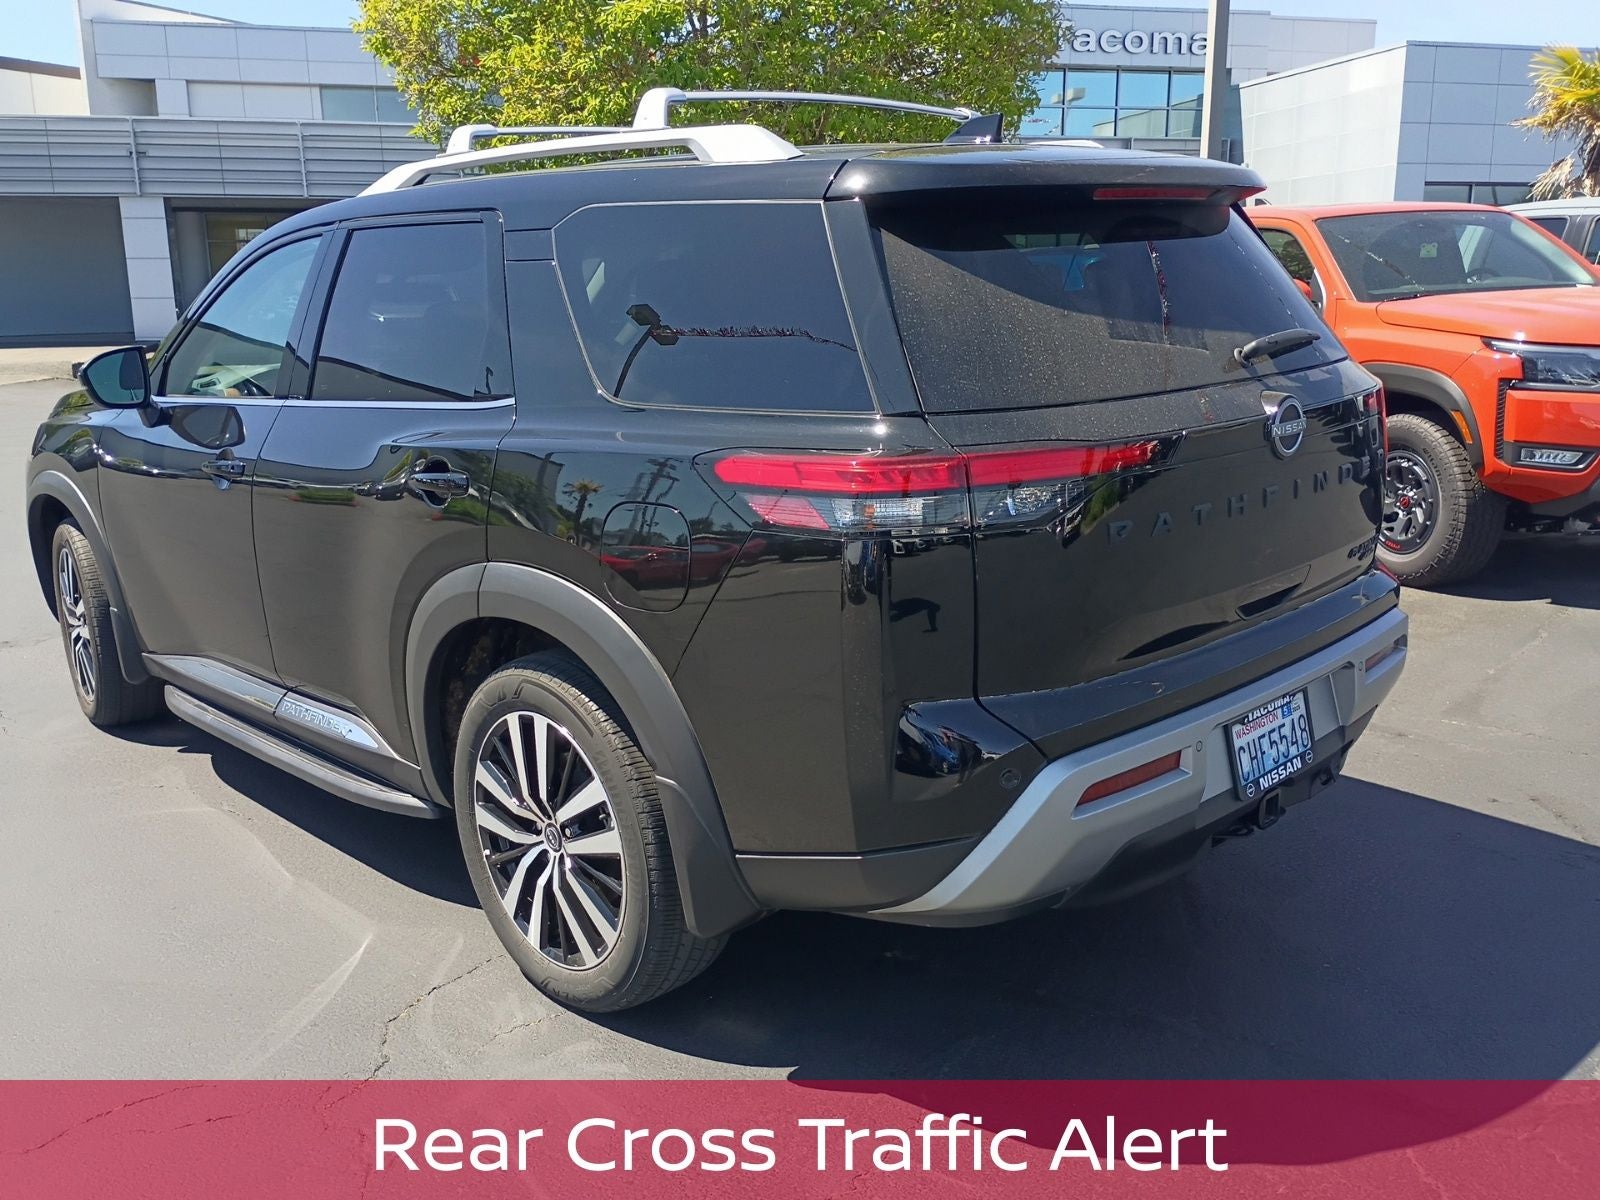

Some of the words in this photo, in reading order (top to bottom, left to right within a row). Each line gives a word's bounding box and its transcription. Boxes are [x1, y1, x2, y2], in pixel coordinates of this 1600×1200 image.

[1273, 420, 1307, 436] NISSAN
[1235, 711, 1279, 740] WASHINGTON
[1238, 714, 1310, 783] CHF5548
[1259, 756, 1303, 791] NISSAN
